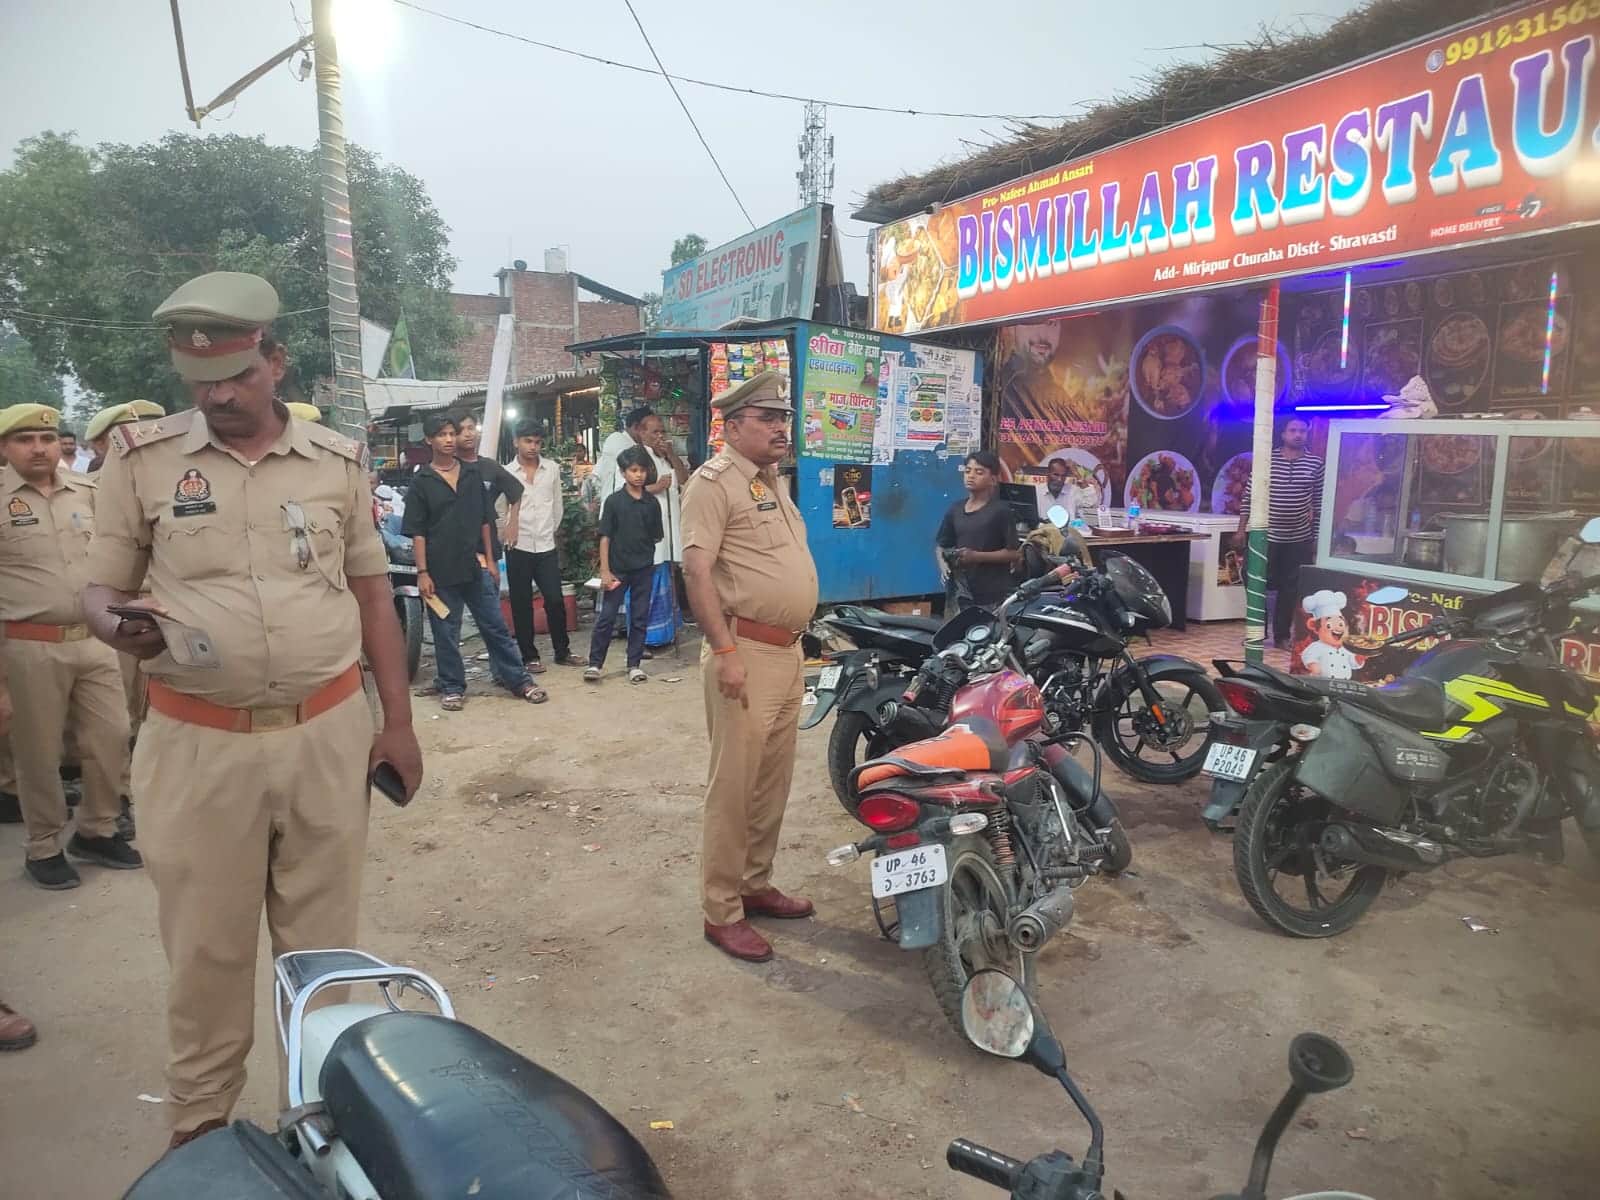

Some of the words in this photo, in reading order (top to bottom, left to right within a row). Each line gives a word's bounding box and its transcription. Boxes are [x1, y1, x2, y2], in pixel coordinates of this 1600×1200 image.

[956, 154, 1219, 299] BISMILLAH
[1230, 34, 1600, 236] RESTAU
[1027, 173, 1060, 194] Ahmad
[1062, 161, 1094, 184] Ansari
[1430, 224, 1457, 238] HOME
[1459, 217, 1501, 232] DELIVERY
[1153, 268, 1180, 282] Add-
[1182, 257, 1231, 277] Mirjapur
[1233, 248, 1284, 268] Churaha
[1287, 241, 1326, 259] Distt-
[1329, 224, 1398, 252] Shravasti
[678, 269, 693, 300] SD
[696, 230, 785, 294] ELECTRONIC
[1432, 592, 1463, 611] Naf
[1220, 745, 1233, 758] UP
[1234, 749, 1247, 762] 46
[886, 857, 901, 873] UP
[911, 852, 927, 867] 46
[905, 869, 936, 887] 3763
